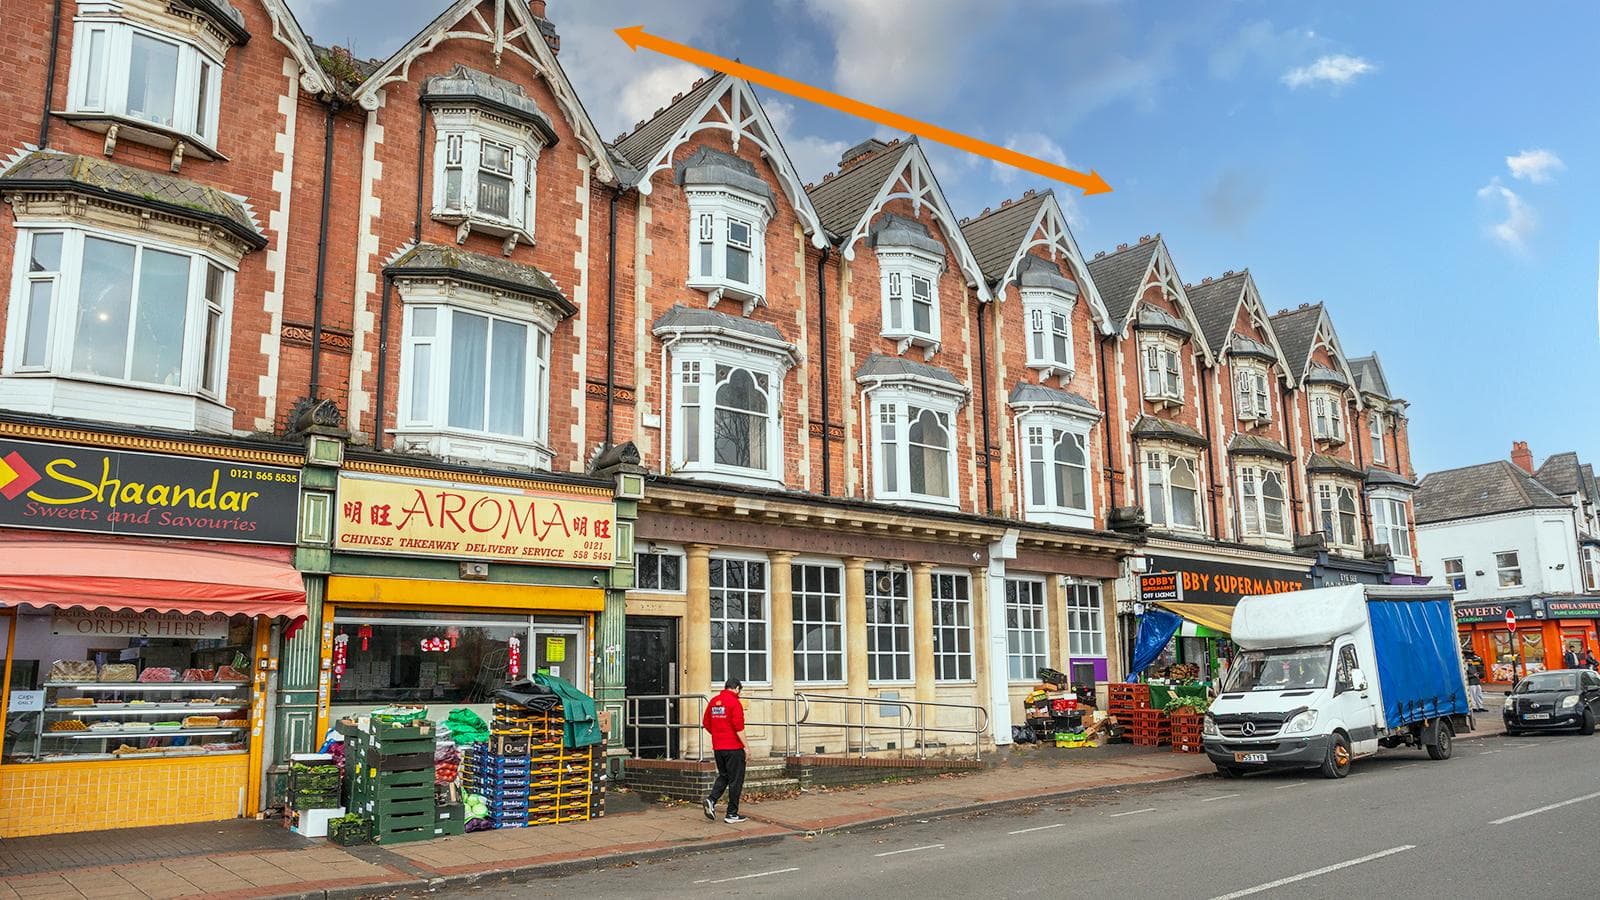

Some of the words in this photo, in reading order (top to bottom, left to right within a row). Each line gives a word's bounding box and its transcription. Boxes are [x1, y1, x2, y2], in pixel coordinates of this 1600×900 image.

[26, 456, 260, 513] Shaandar
[230, 468, 254, 479] 0121
[256, 470, 274, 481] 565
[275, 472, 298, 483] 5535
[23, 502, 99, 521] Sweets
[106, 507, 158, 525] and
[158, 511, 258, 532] Savouries
[343, 500, 393, 527] 明旺
[396, 488, 571, 542] AROMA
[573, 516, 611, 539] 明旺
[341, 533, 394, 547] CHINESE
[399, 537, 460, 552] TAKEAWAY
[464, 542, 519, 555] DELIVERY
[521, 546, 565, 558] SERVICE
[572, 550, 589, 559] 558
[583, 541, 604, 551] 0121
[1142, 576, 1175, 586] BOBBY
[1457, 606, 1503, 618] SWEETS
[77, 618, 149, 635] ORDER
[157, 620, 206, 636] HERE
